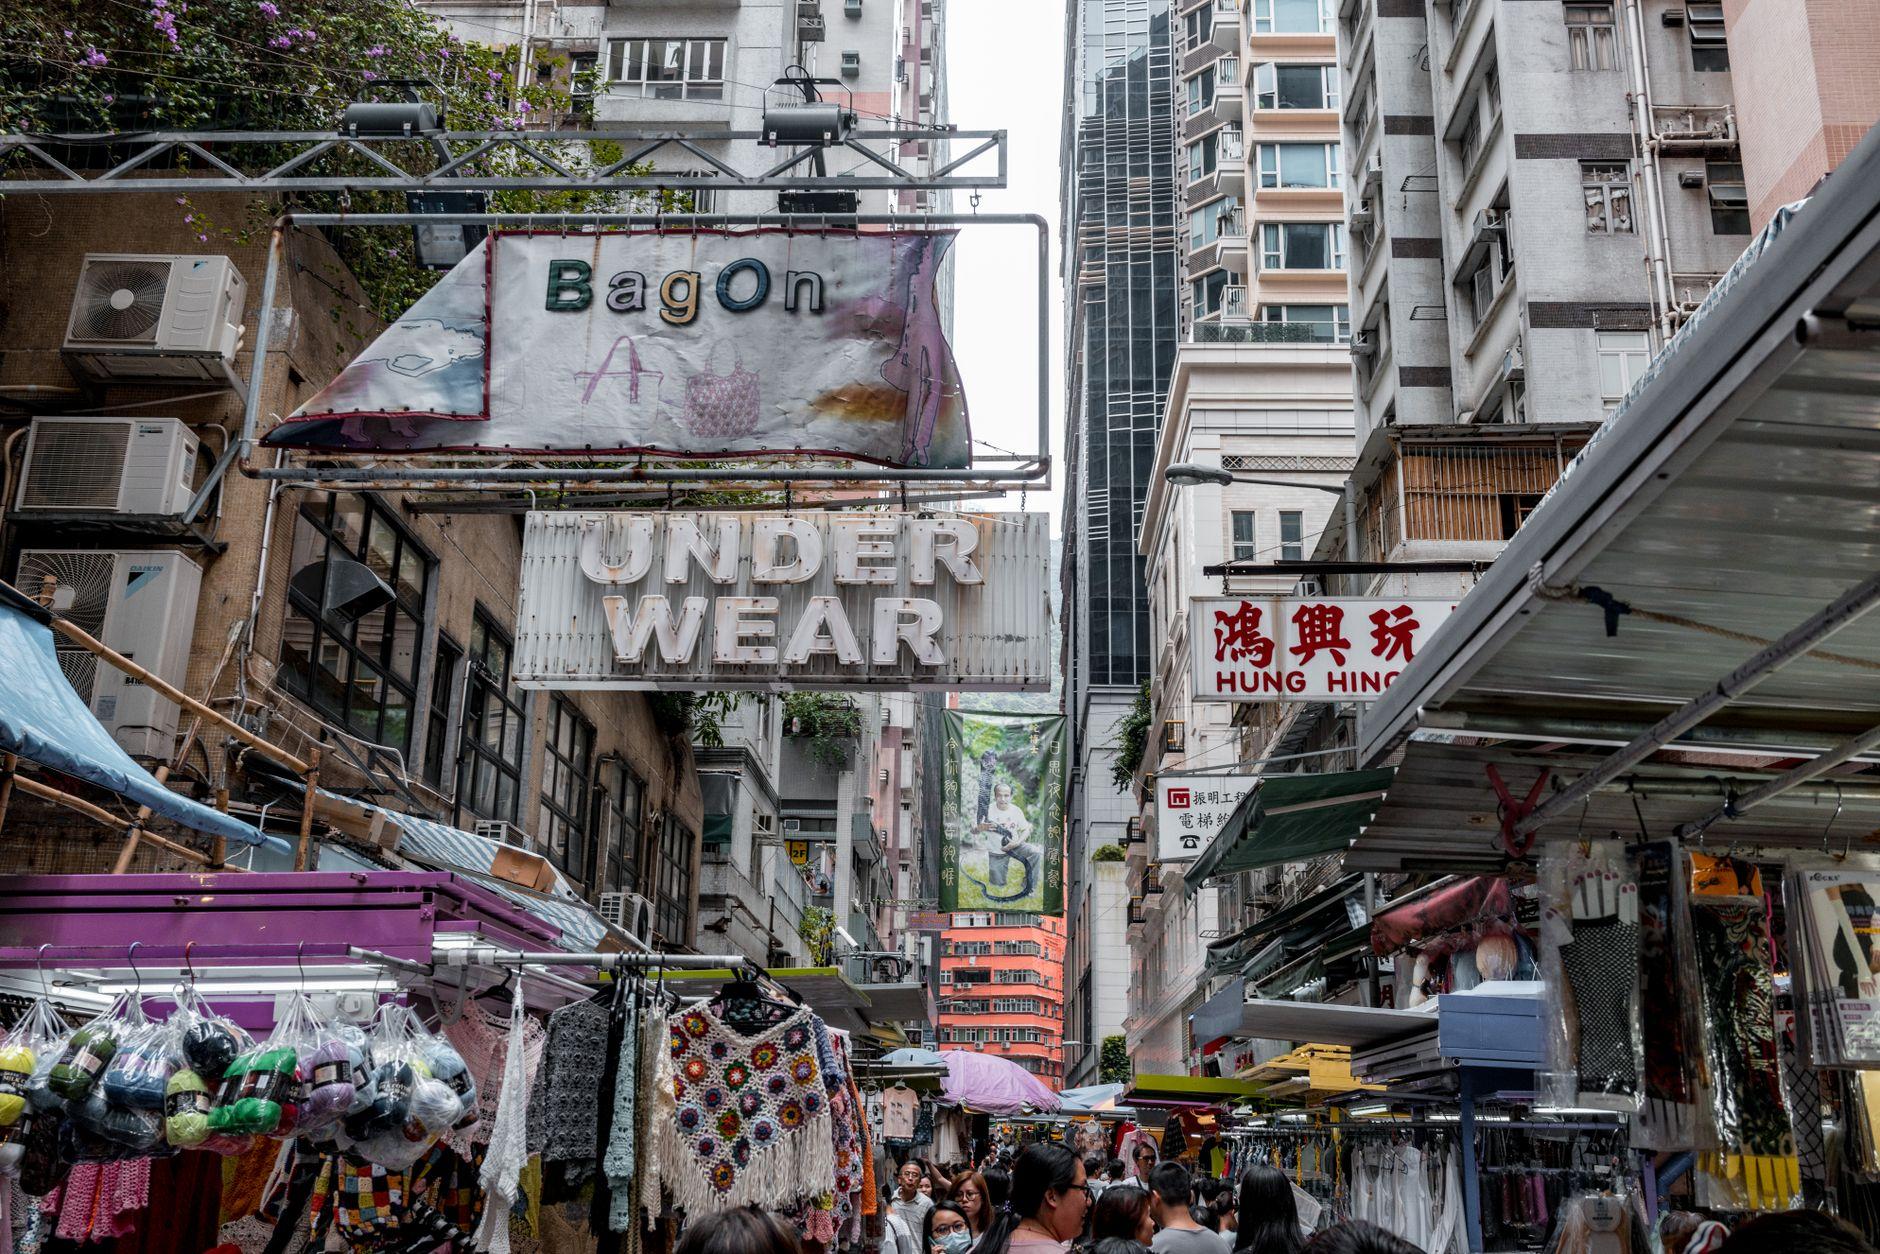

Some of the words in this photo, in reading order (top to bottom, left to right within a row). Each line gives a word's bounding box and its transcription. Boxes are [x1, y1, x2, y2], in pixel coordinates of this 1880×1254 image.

[545, 256, 825, 326] BagOn
[578, 516, 985, 586] UNDER
[602, 595, 945, 666] WEAR
[1214, 600, 1457, 668] 鴻興玩
[1216, 671, 1306, 693] HUNG
